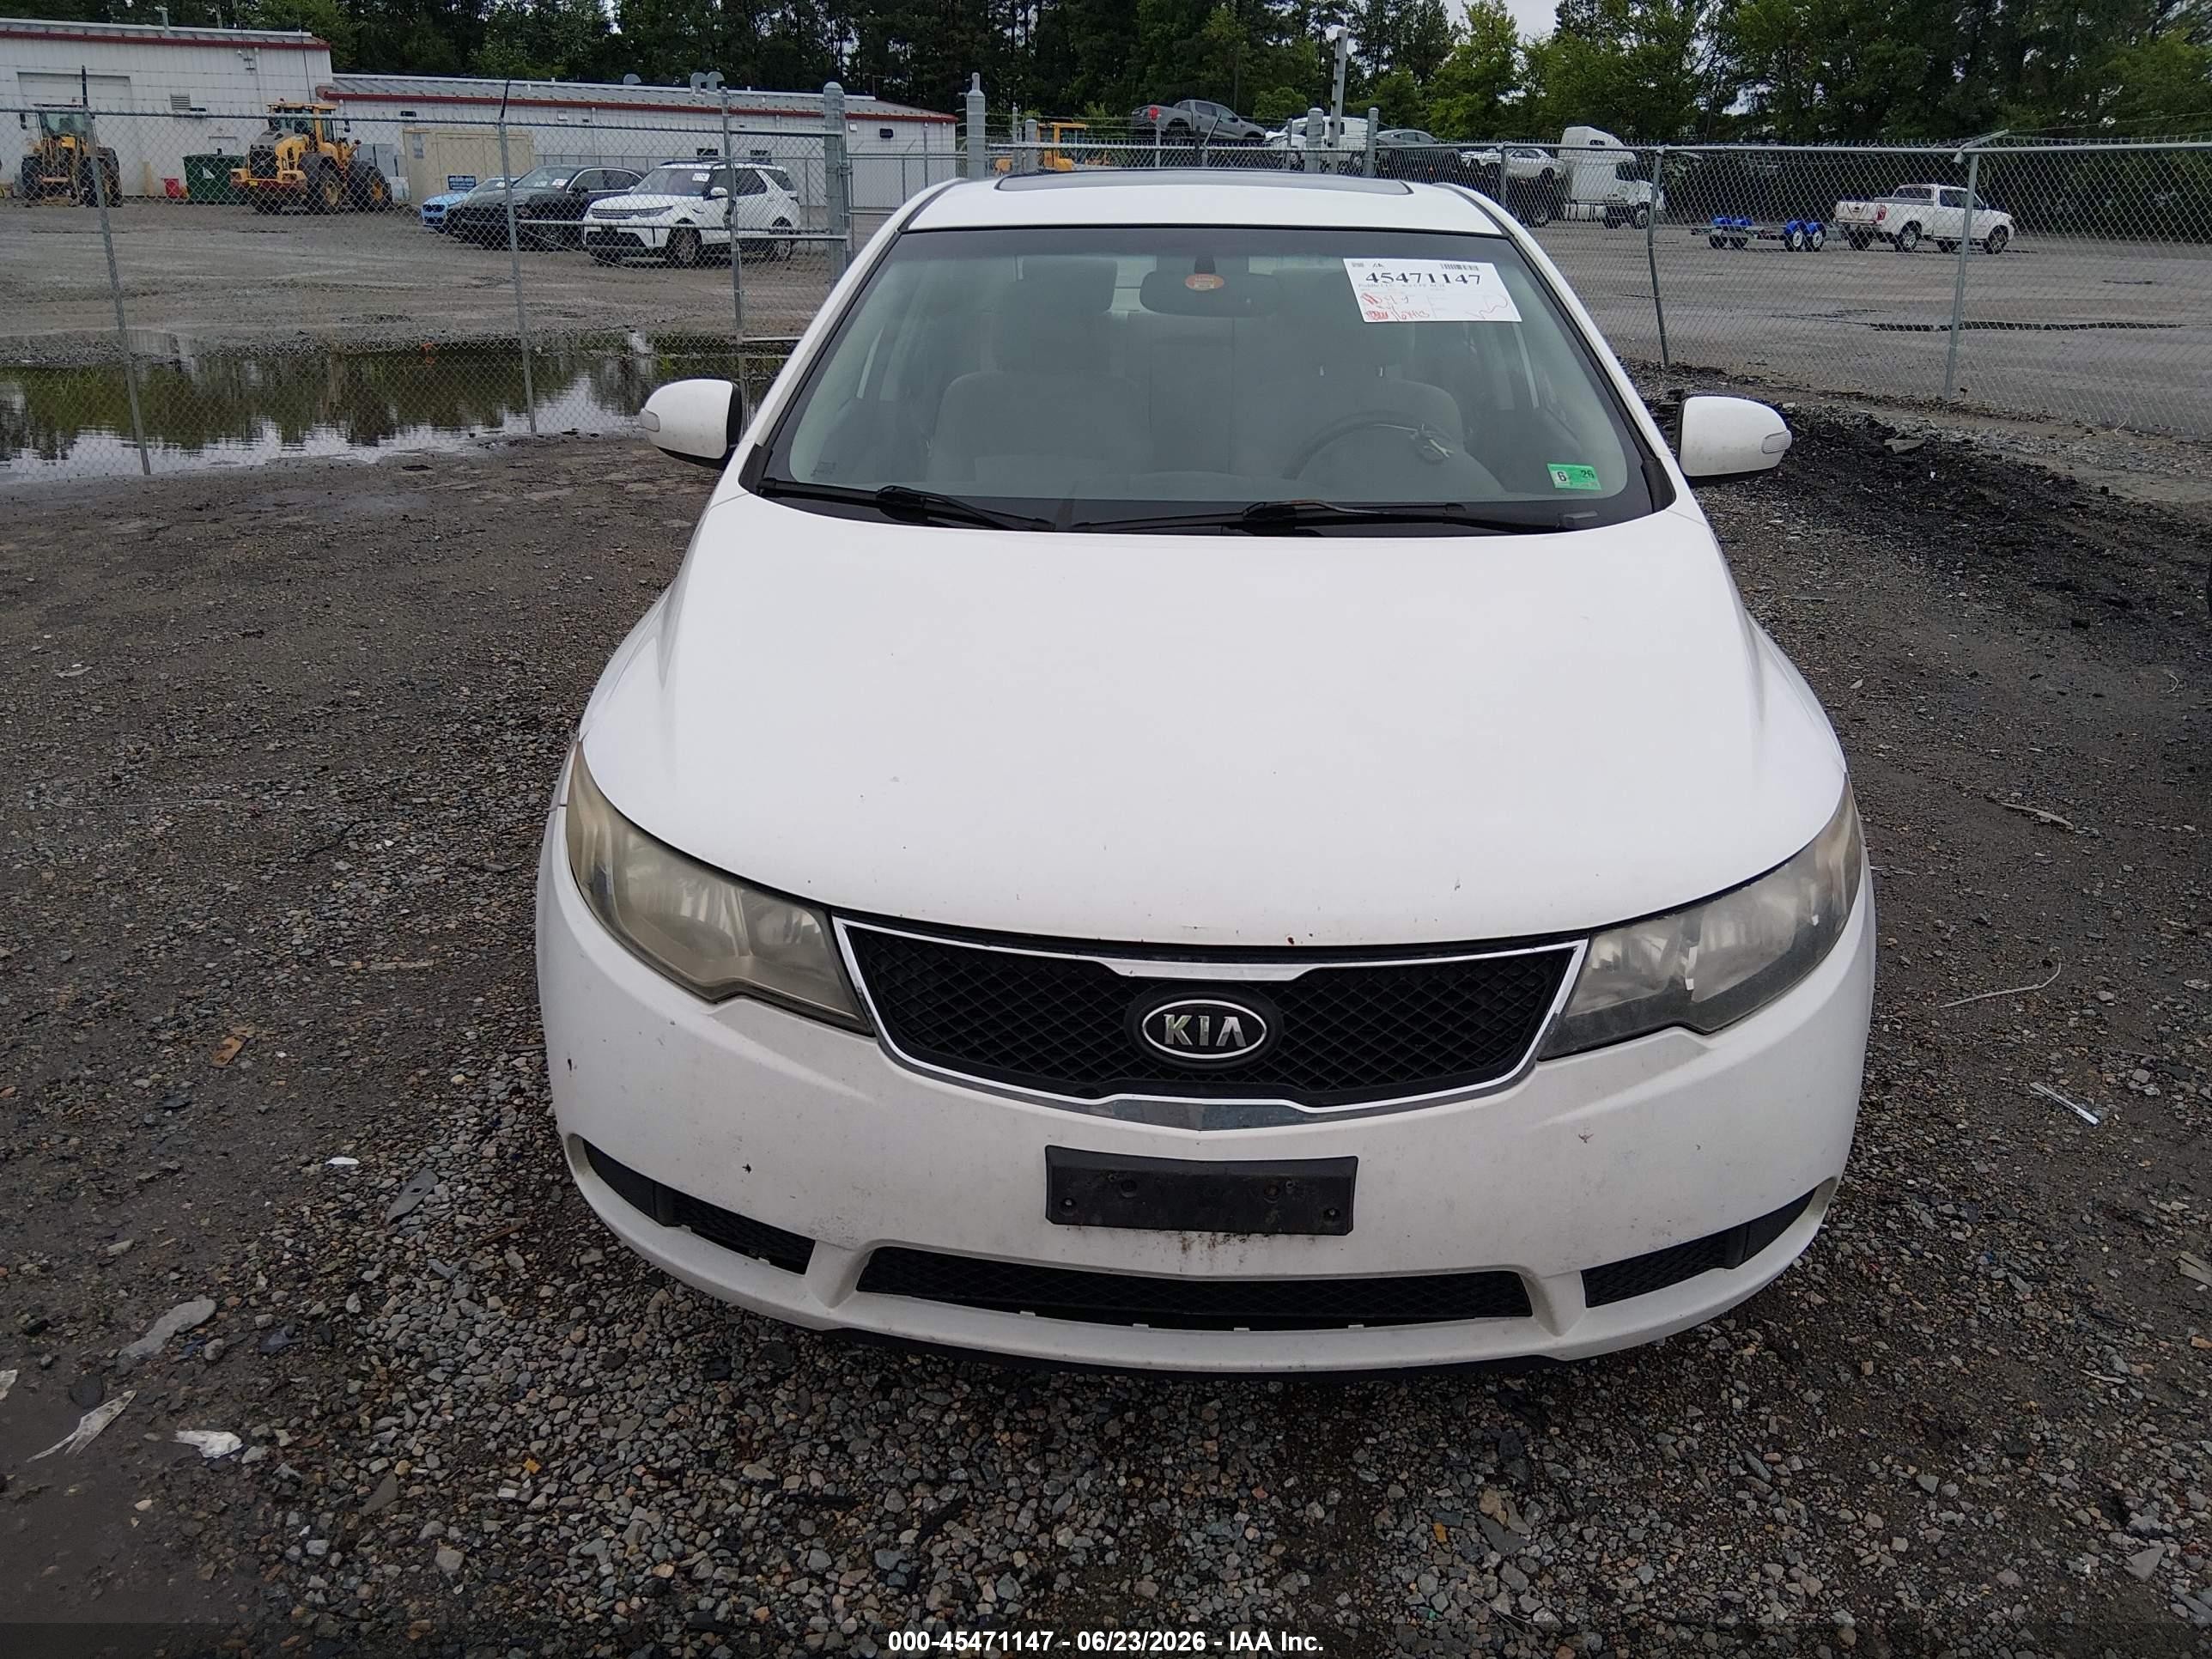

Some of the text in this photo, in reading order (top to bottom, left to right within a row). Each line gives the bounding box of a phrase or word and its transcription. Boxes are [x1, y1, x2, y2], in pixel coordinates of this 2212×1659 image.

[1365, 272, 1480, 284] 45471147
[1558, 471, 1567, 481] 6
[1163, 1014, 1247, 1047] KIA
